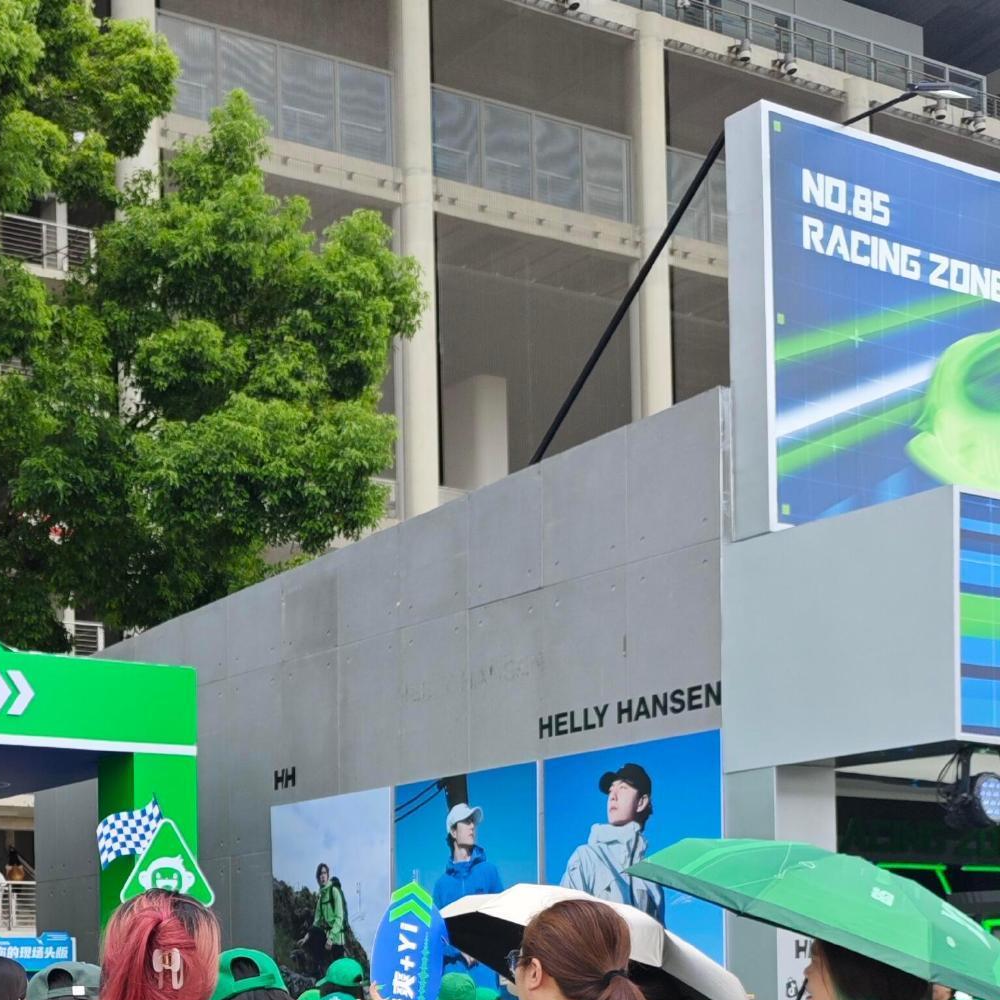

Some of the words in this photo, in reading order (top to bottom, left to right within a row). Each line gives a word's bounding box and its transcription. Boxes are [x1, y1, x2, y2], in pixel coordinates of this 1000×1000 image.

[802, 168, 890, 227] NO.85
[802, 215, 921, 281] RACING
[538, 703, 609, 739] HELLY
[617, 680, 721, 724] HANSEN
[274, 766, 296, 791] HH
